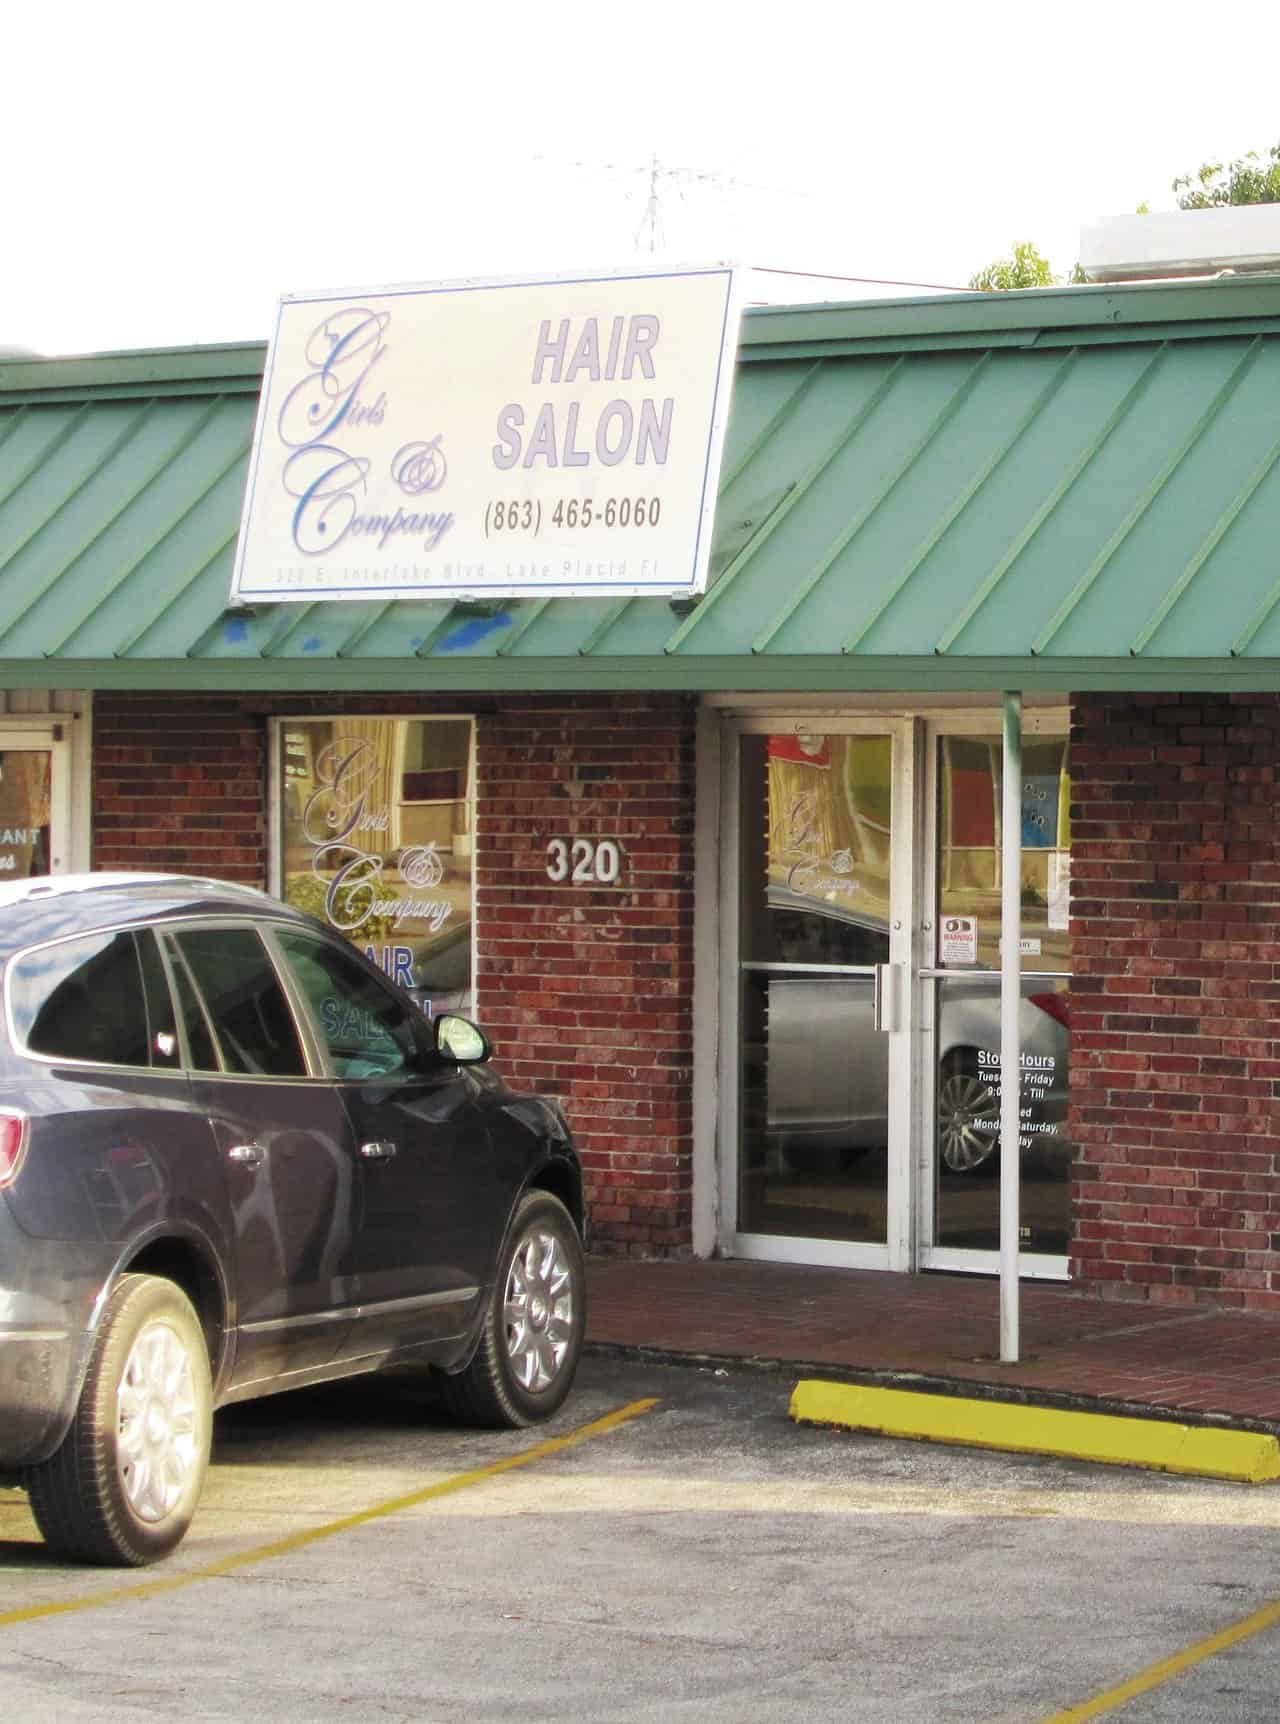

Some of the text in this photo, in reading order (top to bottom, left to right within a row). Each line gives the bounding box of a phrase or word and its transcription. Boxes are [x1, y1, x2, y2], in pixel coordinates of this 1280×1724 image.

[531, 314, 661, 385] HAIR
[492, 397, 674, 471] SALON
[391, 433, 447, 495] &
[282, 443, 456, 557] Company
[485, 497, 661, 539] (863) 465-6060
[398, 841, 444, 889] &
[546, 838, 620, 882] 320
[312, 842, 453, 932] Company
[364, 943, 417, 989] AIR
[1024, 1073, 1055, 1087] Friday
[1030, 1087, 1044, 1099] Till
[1018, 1121, 1058, 1135] aturday,
